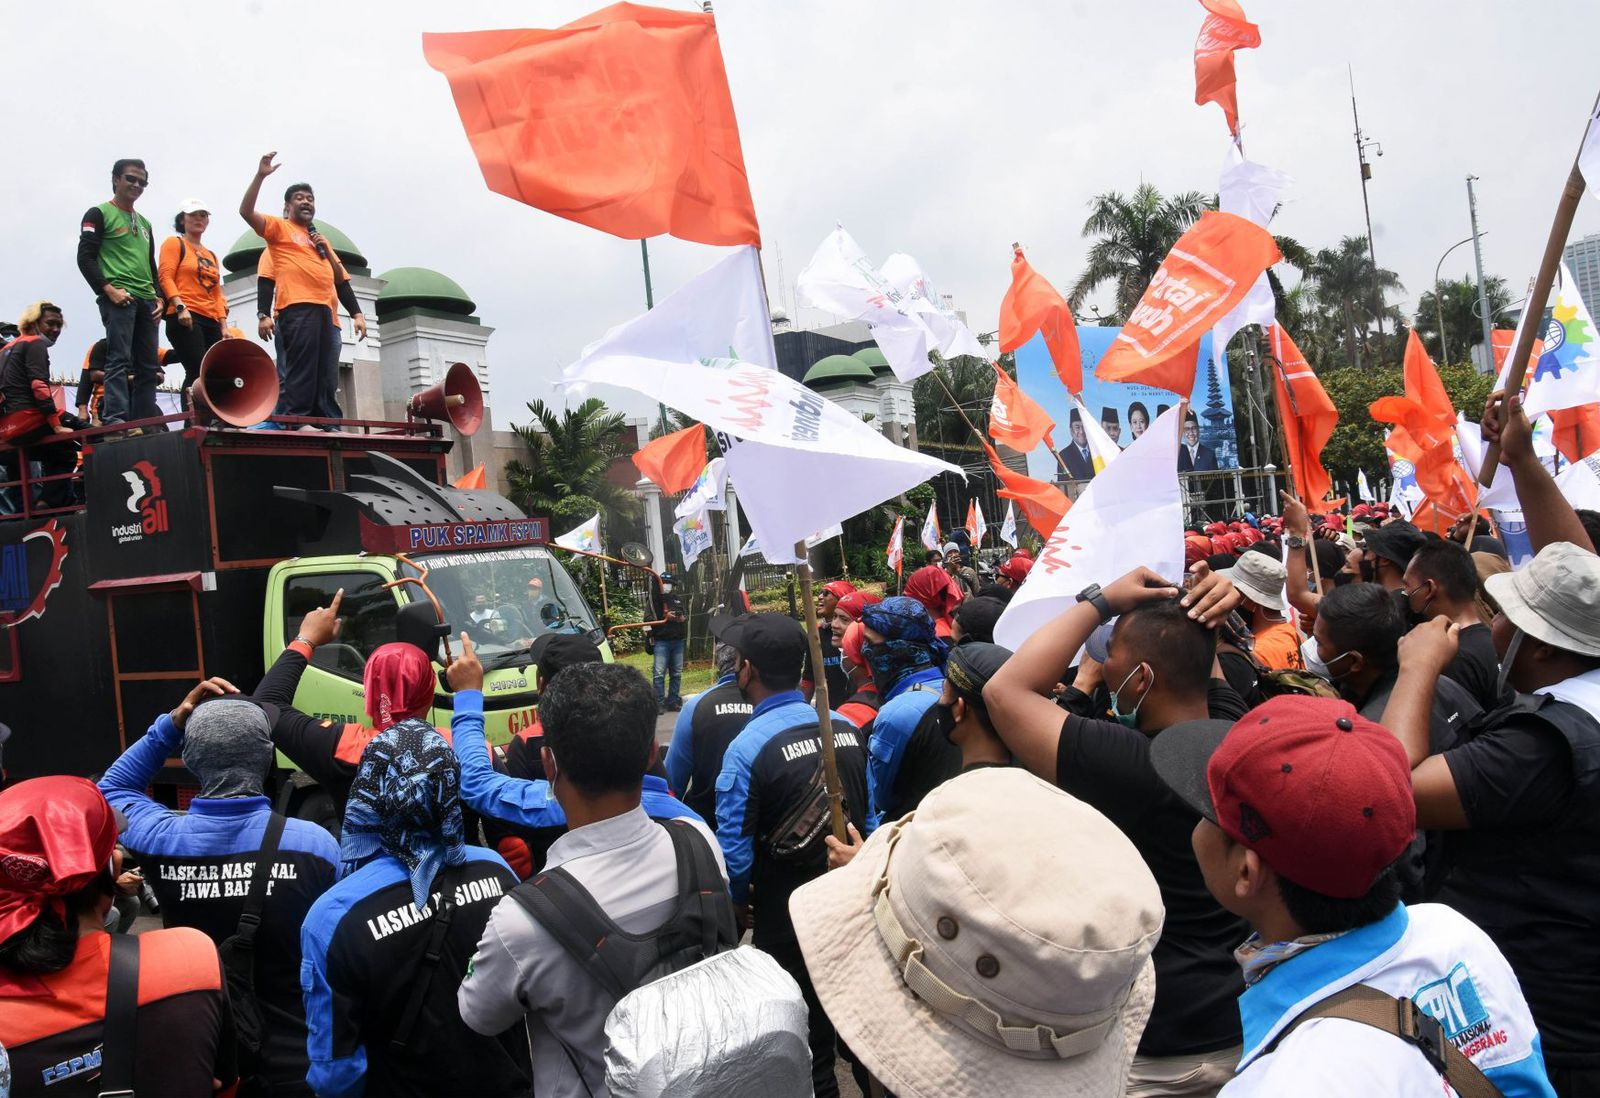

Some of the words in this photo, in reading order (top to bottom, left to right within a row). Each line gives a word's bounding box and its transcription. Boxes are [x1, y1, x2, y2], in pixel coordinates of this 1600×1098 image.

[410, 526, 452, 548] PUK
[509, 521, 542, 542] FSPMI
[427, 556, 449, 570] HINO
[446, 554, 477, 567] MOTORS
[490, 678, 528, 692] HINO
[781, 739, 818, 762] LASKAR
[159, 864, 219, 881] LASKAR
[180, 881, 221, 901] JAWA
